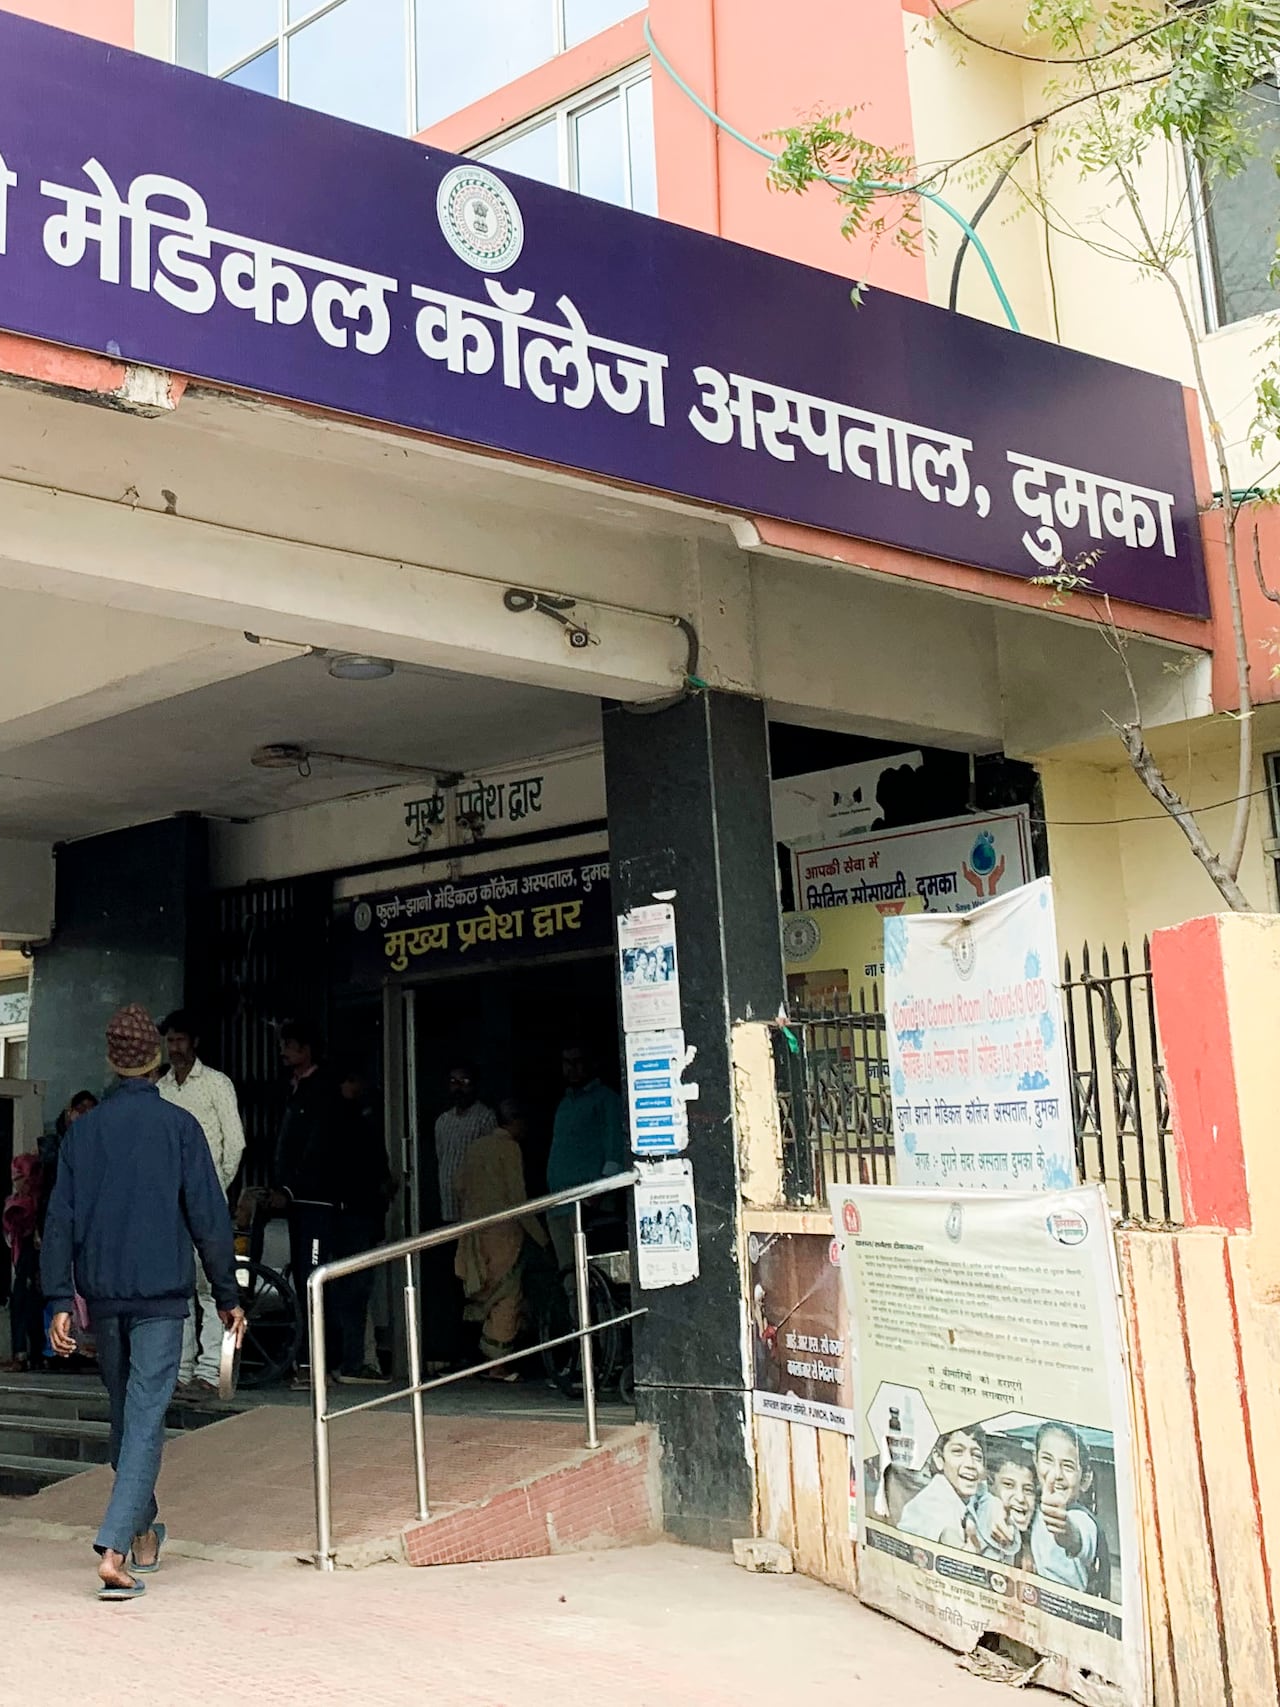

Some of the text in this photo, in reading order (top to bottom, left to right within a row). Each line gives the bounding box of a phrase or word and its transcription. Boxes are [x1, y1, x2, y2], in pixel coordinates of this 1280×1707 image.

[40, 157, 398, 355] मेडिकल
[412, 278, 669, 427] कॉलेज
[688, 366, 991, 519] अस्पताल,
[1007, 449, 1176, 568] दुमका
[508, 776, 545, 822] द्वार
[805, 851, 881, 880] आपकी सेवा में
[376, 889, 433, 928] फुलो-झानो
[434, 884, 478, 908] मेडिकल
[479, 876, 519, 901] कॉलेज
[521, 868, 578, 895] अस्पताल,
[806, 884, 848, 909] सिविल
[916, 872, 957, 910] दुमका
[384, 922, 451, 972] मुख्य
[456, 904, 525, 952] प्रवेश
[531, 900, 584, 939] द्वार
[865, 964, 878, 978] ना
[957, 993, 982, 1022] Room
[914, 1098, 932, 1126] झानो
[934, 1097, 962, 1126] मेडिकल
[965, 1096, 990, 1126] कॉलेज
[994, 1101, 1032, 1126] अस्पताल,
[1034, 1098, 1060, 1129] दुमका
[979, 1153, 1008, 1172] अस्पताल
[1011, 1152, 1033, 1178] दुमका
